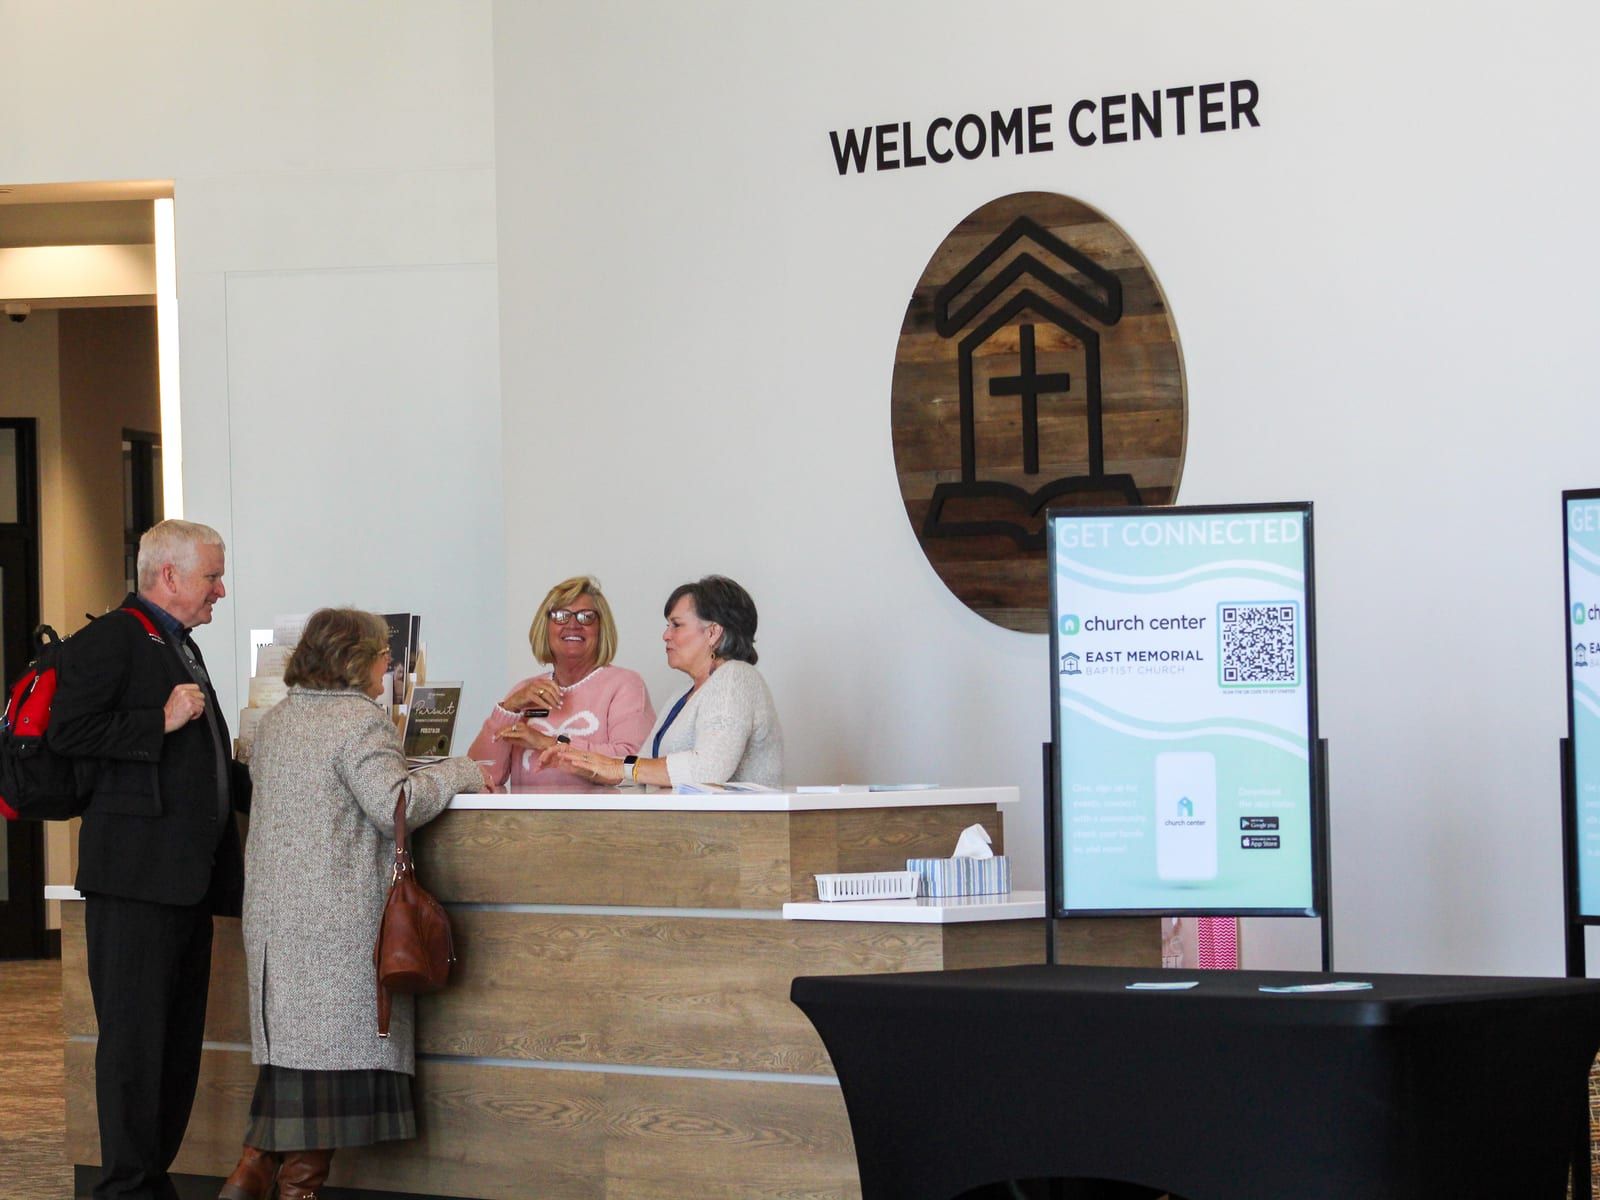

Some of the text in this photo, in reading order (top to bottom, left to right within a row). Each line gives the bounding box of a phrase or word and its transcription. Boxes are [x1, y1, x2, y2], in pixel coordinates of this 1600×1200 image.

[828, 79, 1261, 176] WELCOME CENTER
[1059, 518, 1301, 548] GET CONNECTED
[1084, 614, 1206, 631] church center
[1086, 650, 1204, 662] EAST MEMORIAL
[1085, 665, 1185, 676] BAPTIST CHURCH
[1250, 840, 1278, 848] App Store
